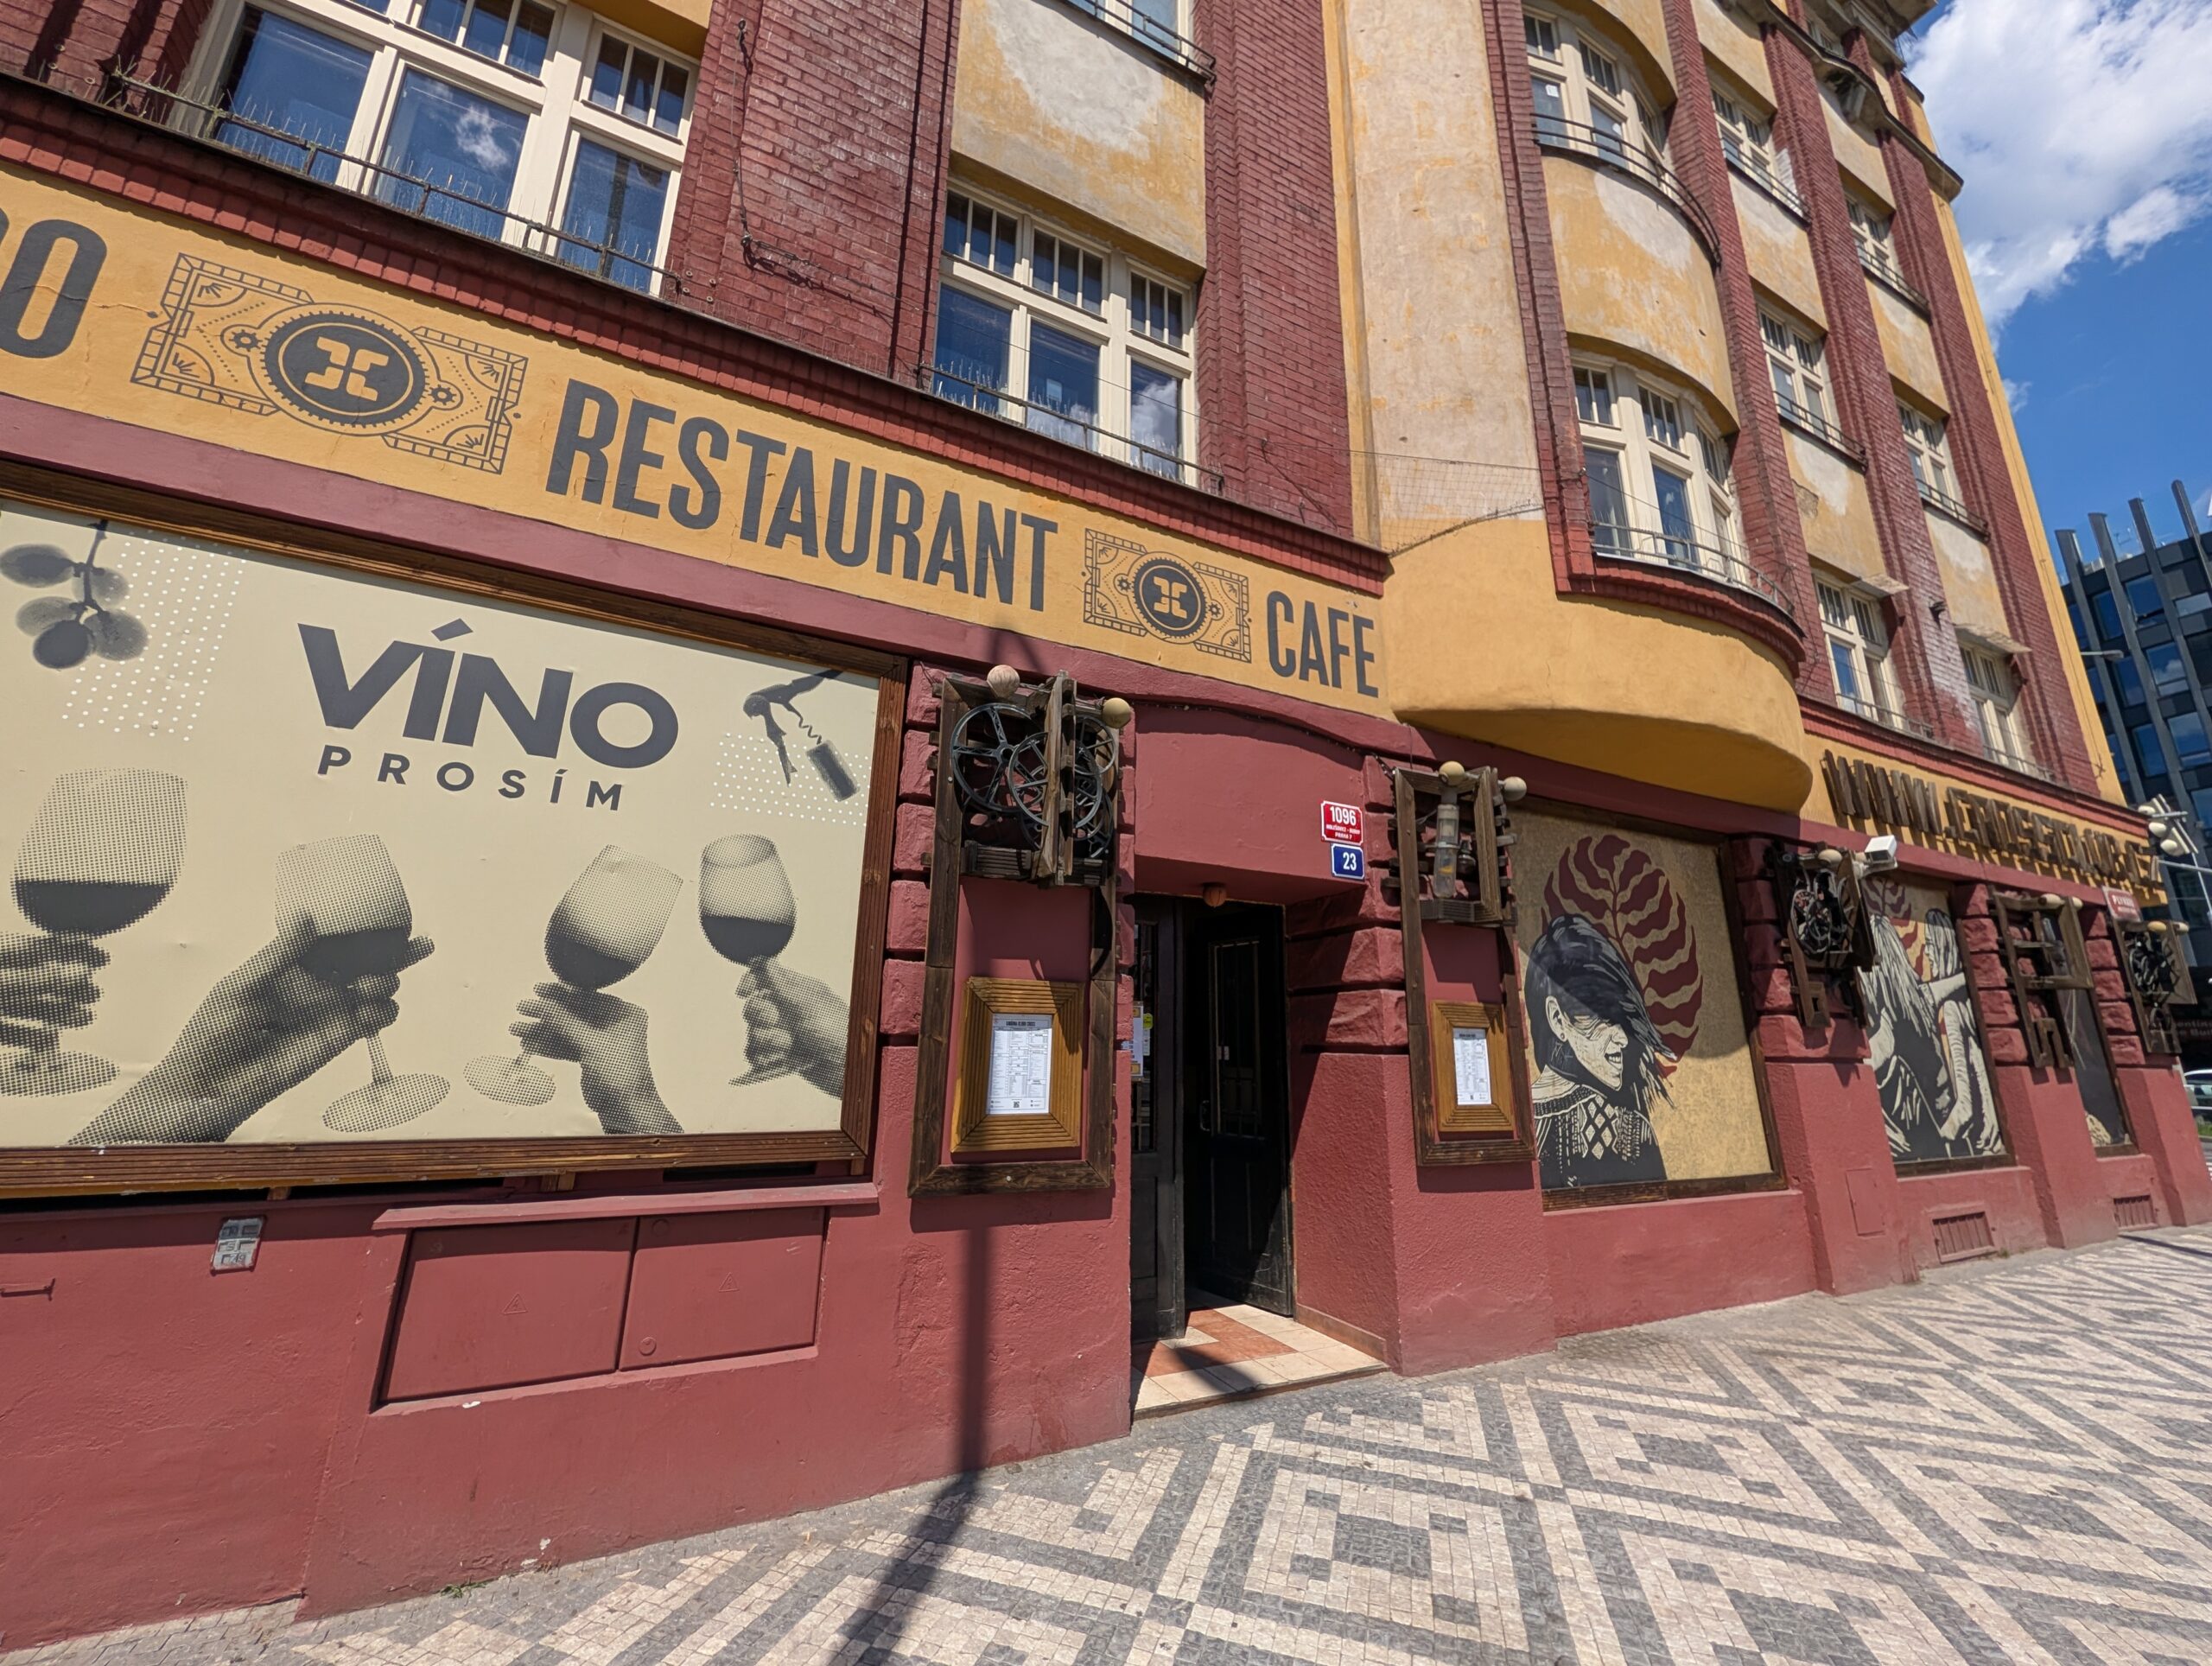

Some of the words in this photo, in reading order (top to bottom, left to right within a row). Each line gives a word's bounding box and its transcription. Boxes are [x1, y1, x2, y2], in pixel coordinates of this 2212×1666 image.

[0, 207, 107, 359] O
[545, 378, 1058, 613] RESTAURANT
[297, 618, 679, 769] VÍNO
[1267, 590, 1379, 698] CAFE
[317, 744, 622, 811] PROSÍM
[1330, 805, 1357, 826] 1096
[1343, 851, 1357, 871] 23
